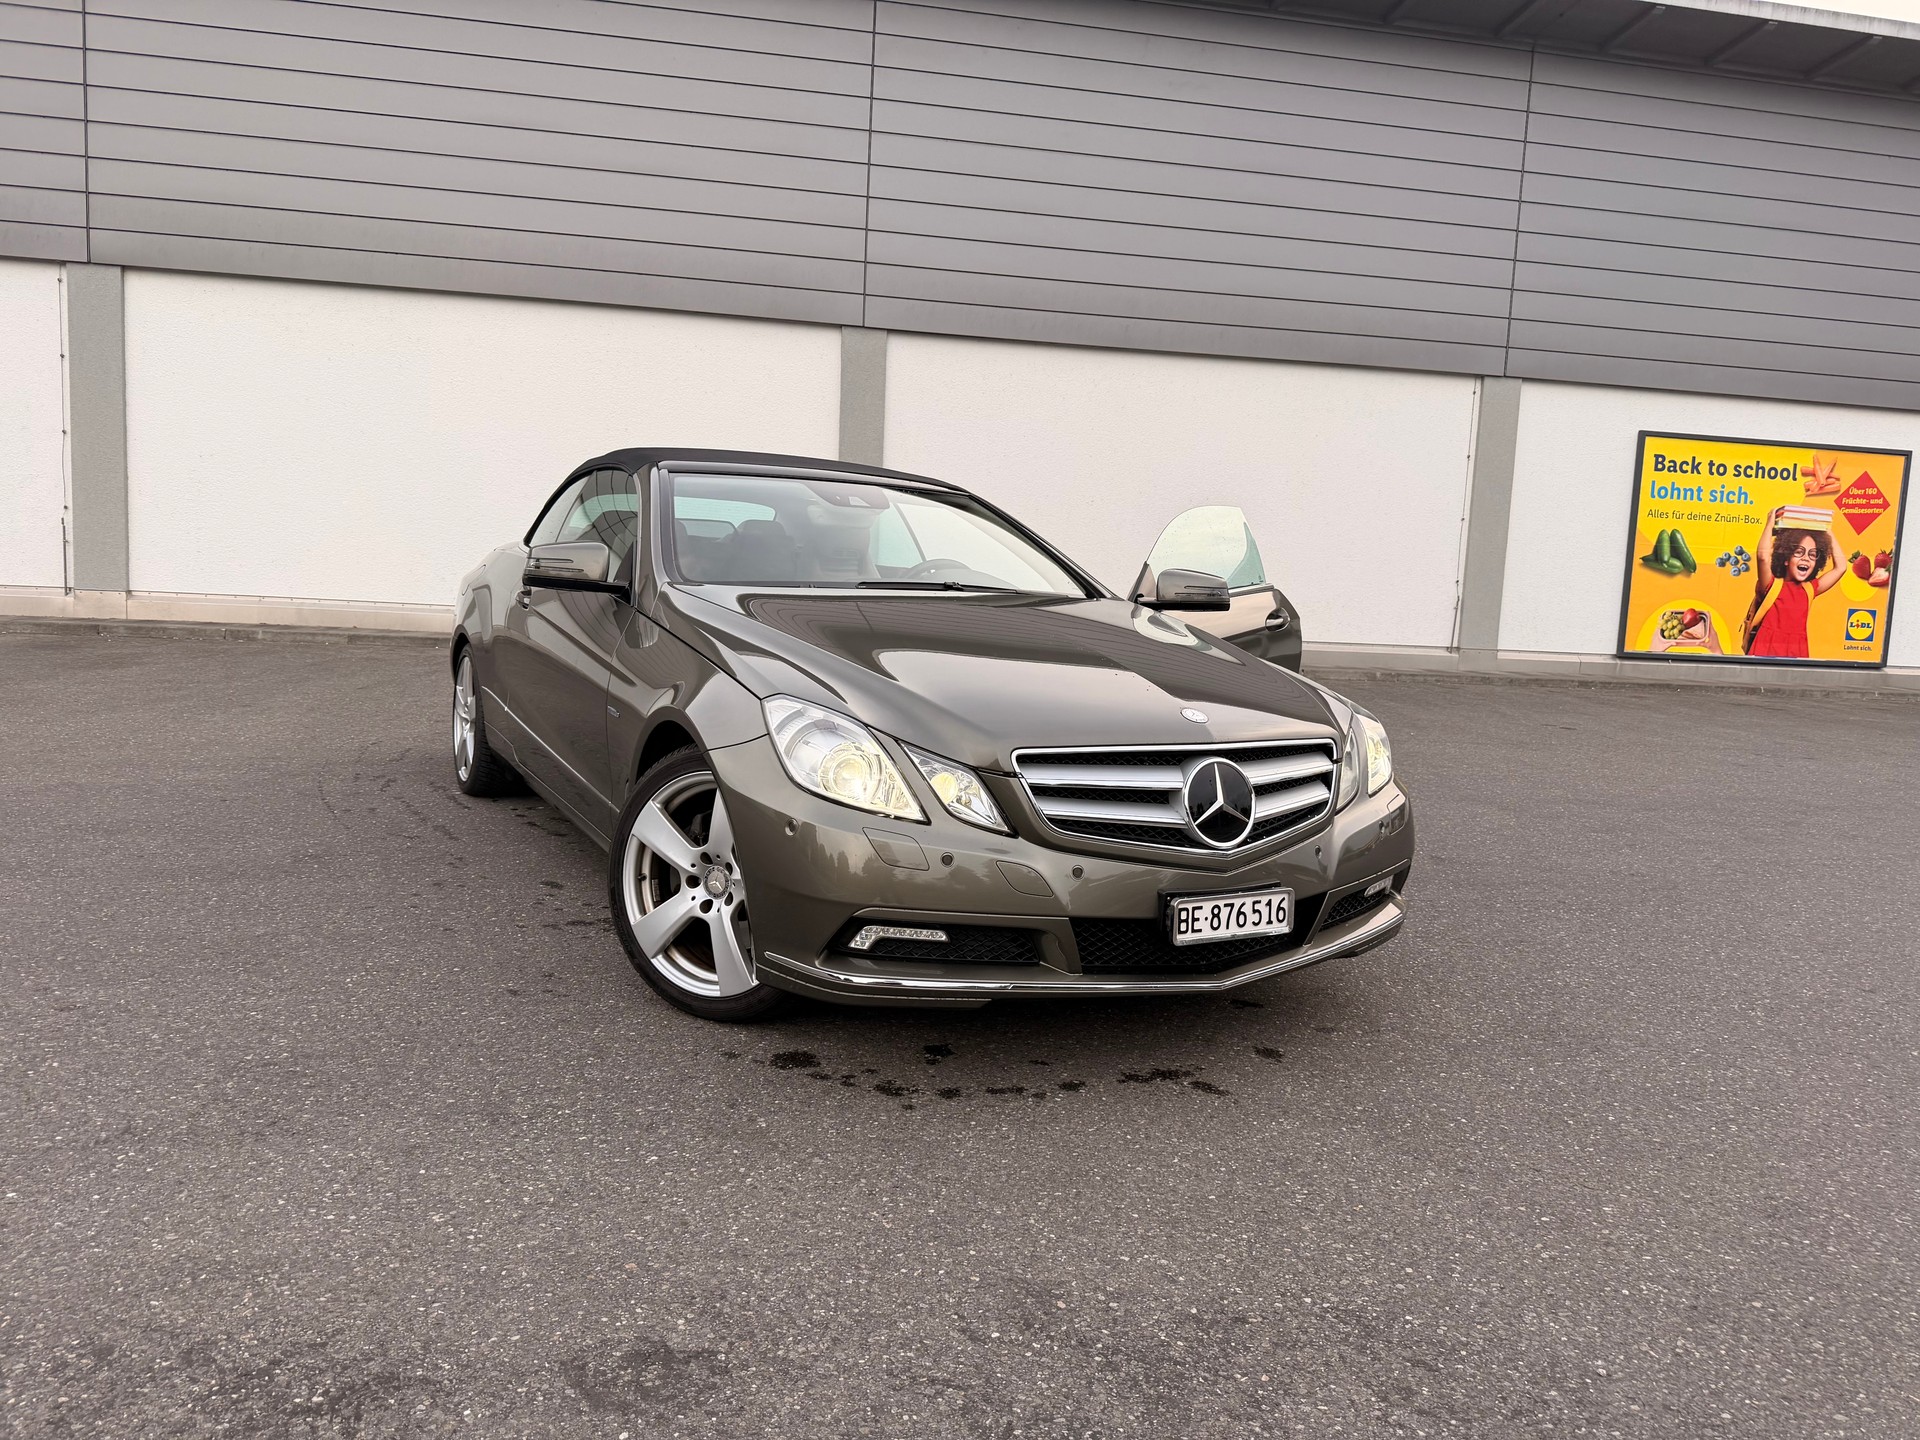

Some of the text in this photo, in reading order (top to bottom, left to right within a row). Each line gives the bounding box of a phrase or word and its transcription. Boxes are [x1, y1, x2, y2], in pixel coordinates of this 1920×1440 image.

[1653, 453, 1797, 482] Back to school
[1650, 480, 1754, 505] lohnt sich.
[1849, 486, 1865, 495] Über
[1842, 497, 1869, 505] Früchte-
[1647, 509, 1763, 525] Alles für deine Znüni-Box.
